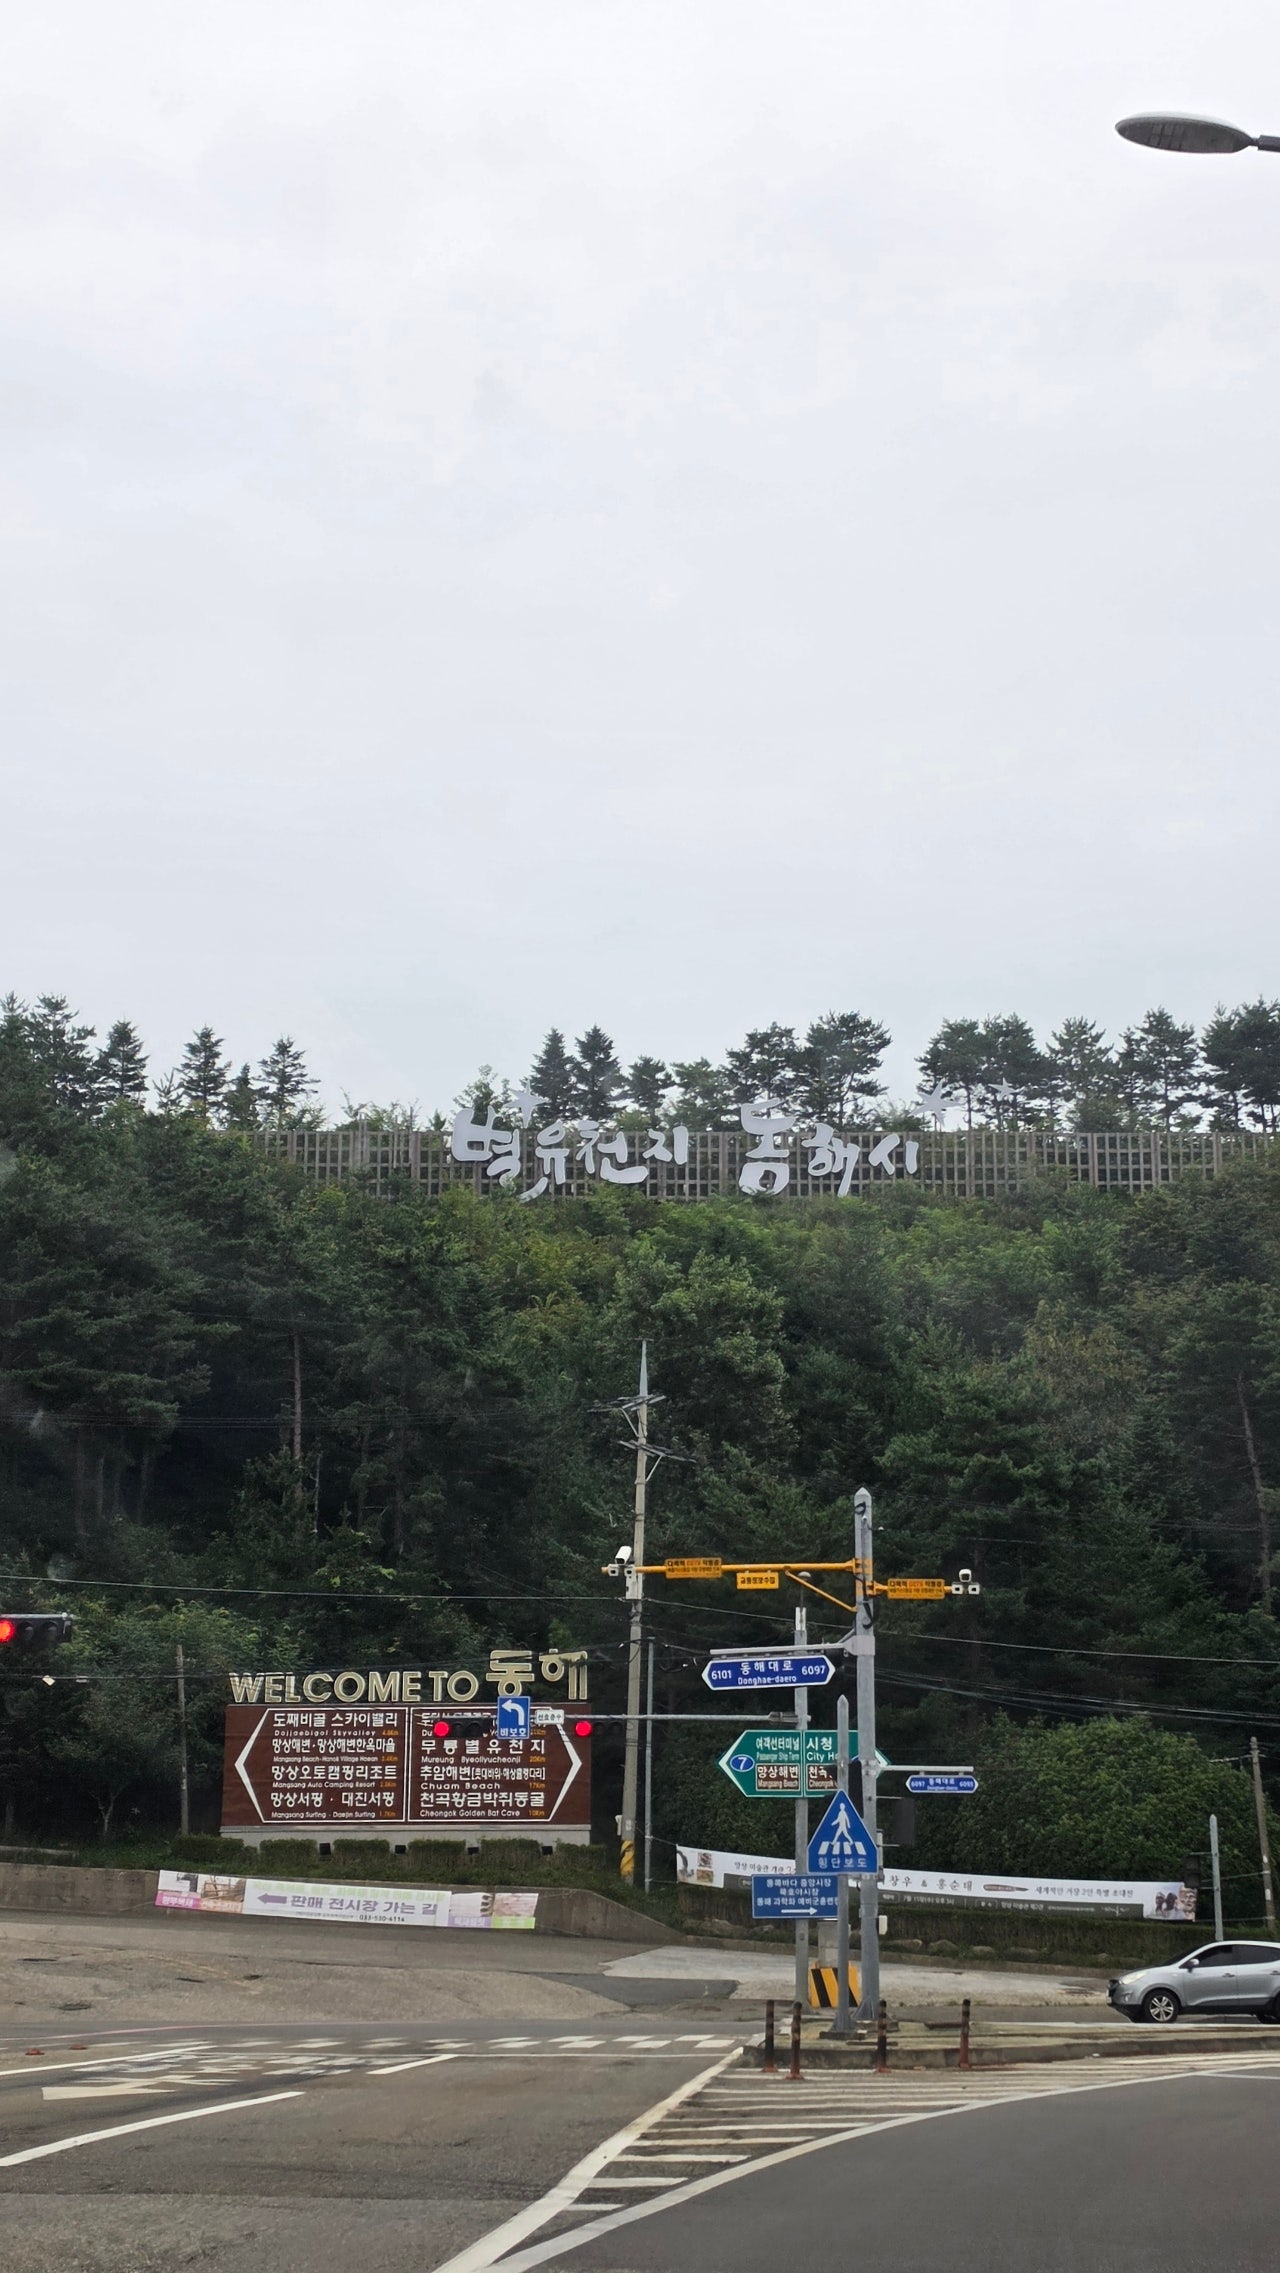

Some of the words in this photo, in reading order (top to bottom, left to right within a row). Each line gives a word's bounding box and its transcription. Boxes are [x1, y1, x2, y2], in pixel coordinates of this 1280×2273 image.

[451, 1106, 689, 1202] 별유천지
[738, 1098, 920, 1197] 동해시
[740, 1660, 794, 1675] 동해대로
[801, 1665, 826, 1675] 6097
[229, 1671, 421, 1703] WELCOME
[428, 1670, 479, 1703] TO
[485, 1648, 588, 1700] 동해
[711, 1670, 732, 1680] 6101
[738, 1675, 797, 1686] Donghae-daero
[273, 1713, 326, 1728] 도째비골
[331, 1713, 398, 1728] 스카이밸리
[500, 1727, 527, 1737] 비보호
[756, 1736, 800, 1750] 여객선터미널
[806, 1736, 833, 1750] 시청
[738, 1757, 748, 1770] 7
[806, 1752, 825, 1762] City
[271, 1765, 398, 1780] 망상오토캠핑리조트
[757, 1765, 799, 1778] 망상해변
[420, 1782, 460, 1790] Chuam
[465, 1782, 501, 1790] Beach
[271, 1792, 323, 1808] 망상서핑
[341, 1792, 395, 1807] 대진서핑
[420, 1791, 545, 1807] 천곡황금박쥐동굴
[271, 1811, 305, 1819] Mangsang
[305, 1811, 327, 1819] Surfing
[355, 1811, 376, 1819] Surfing
[419, 1809, 457, 1817] Cheongok
[459, 1809, 485, 1817] Golden
[488, 1809, 500, 1817] Bat
[501, 1809, 521, 1817] Cave
[818, 1856, 868, 1869] 횡단보도
[290, 1895, 323, 1909] 판매
[328, 1898, 379, 1913] 전시장
[384, 1901, 415, 1914] 가는
[421, 1903, 438, 1915] 길
